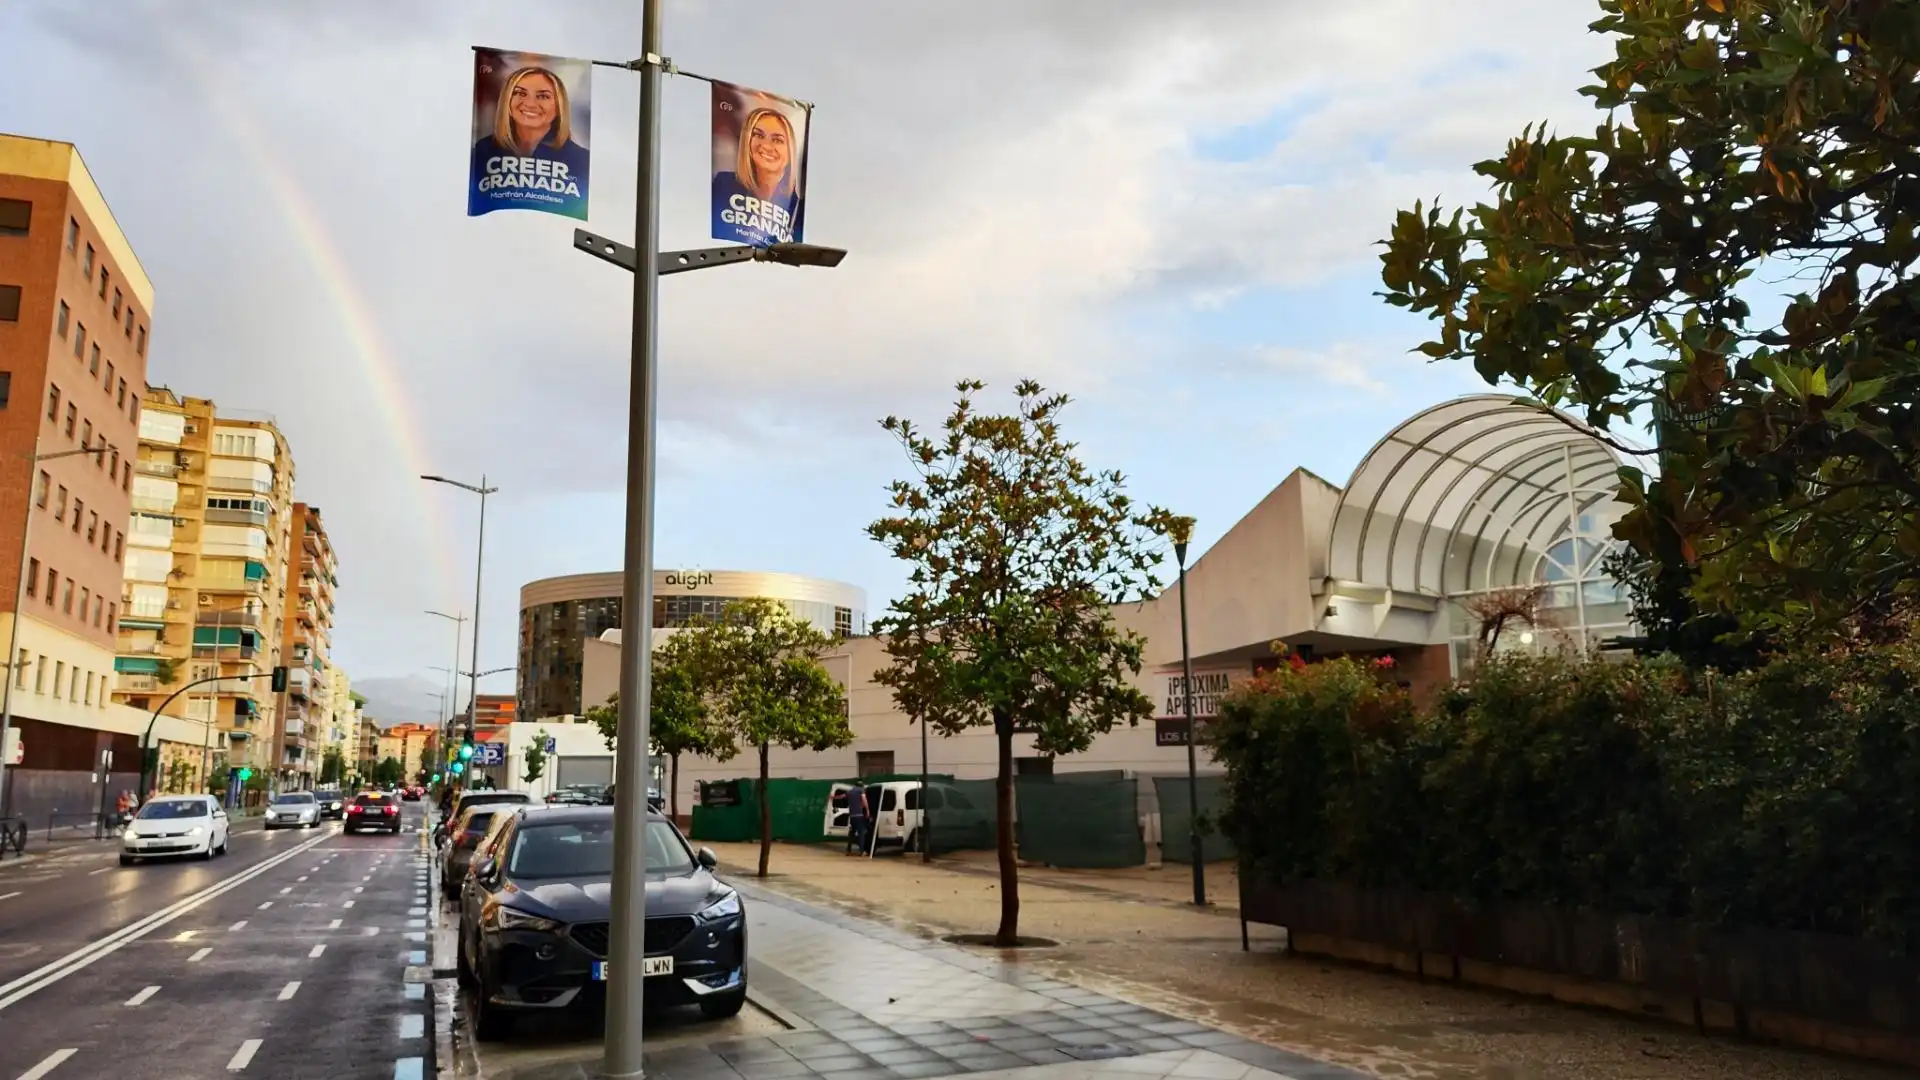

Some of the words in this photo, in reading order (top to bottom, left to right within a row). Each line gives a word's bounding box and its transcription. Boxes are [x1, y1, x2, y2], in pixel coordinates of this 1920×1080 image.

[486, 156, 569, 180] CREER
[478, 174, 581, 198] GRANADA
[525, 191, 564, 204] Alcaldesa
[729, 193, 790, 232] CREER
[721, 209, 794, 243] GRANADA
[665, 571, 713, 590] alight
[546, 739, 554, 749] P
[644, 959, 670, 973] LWN
